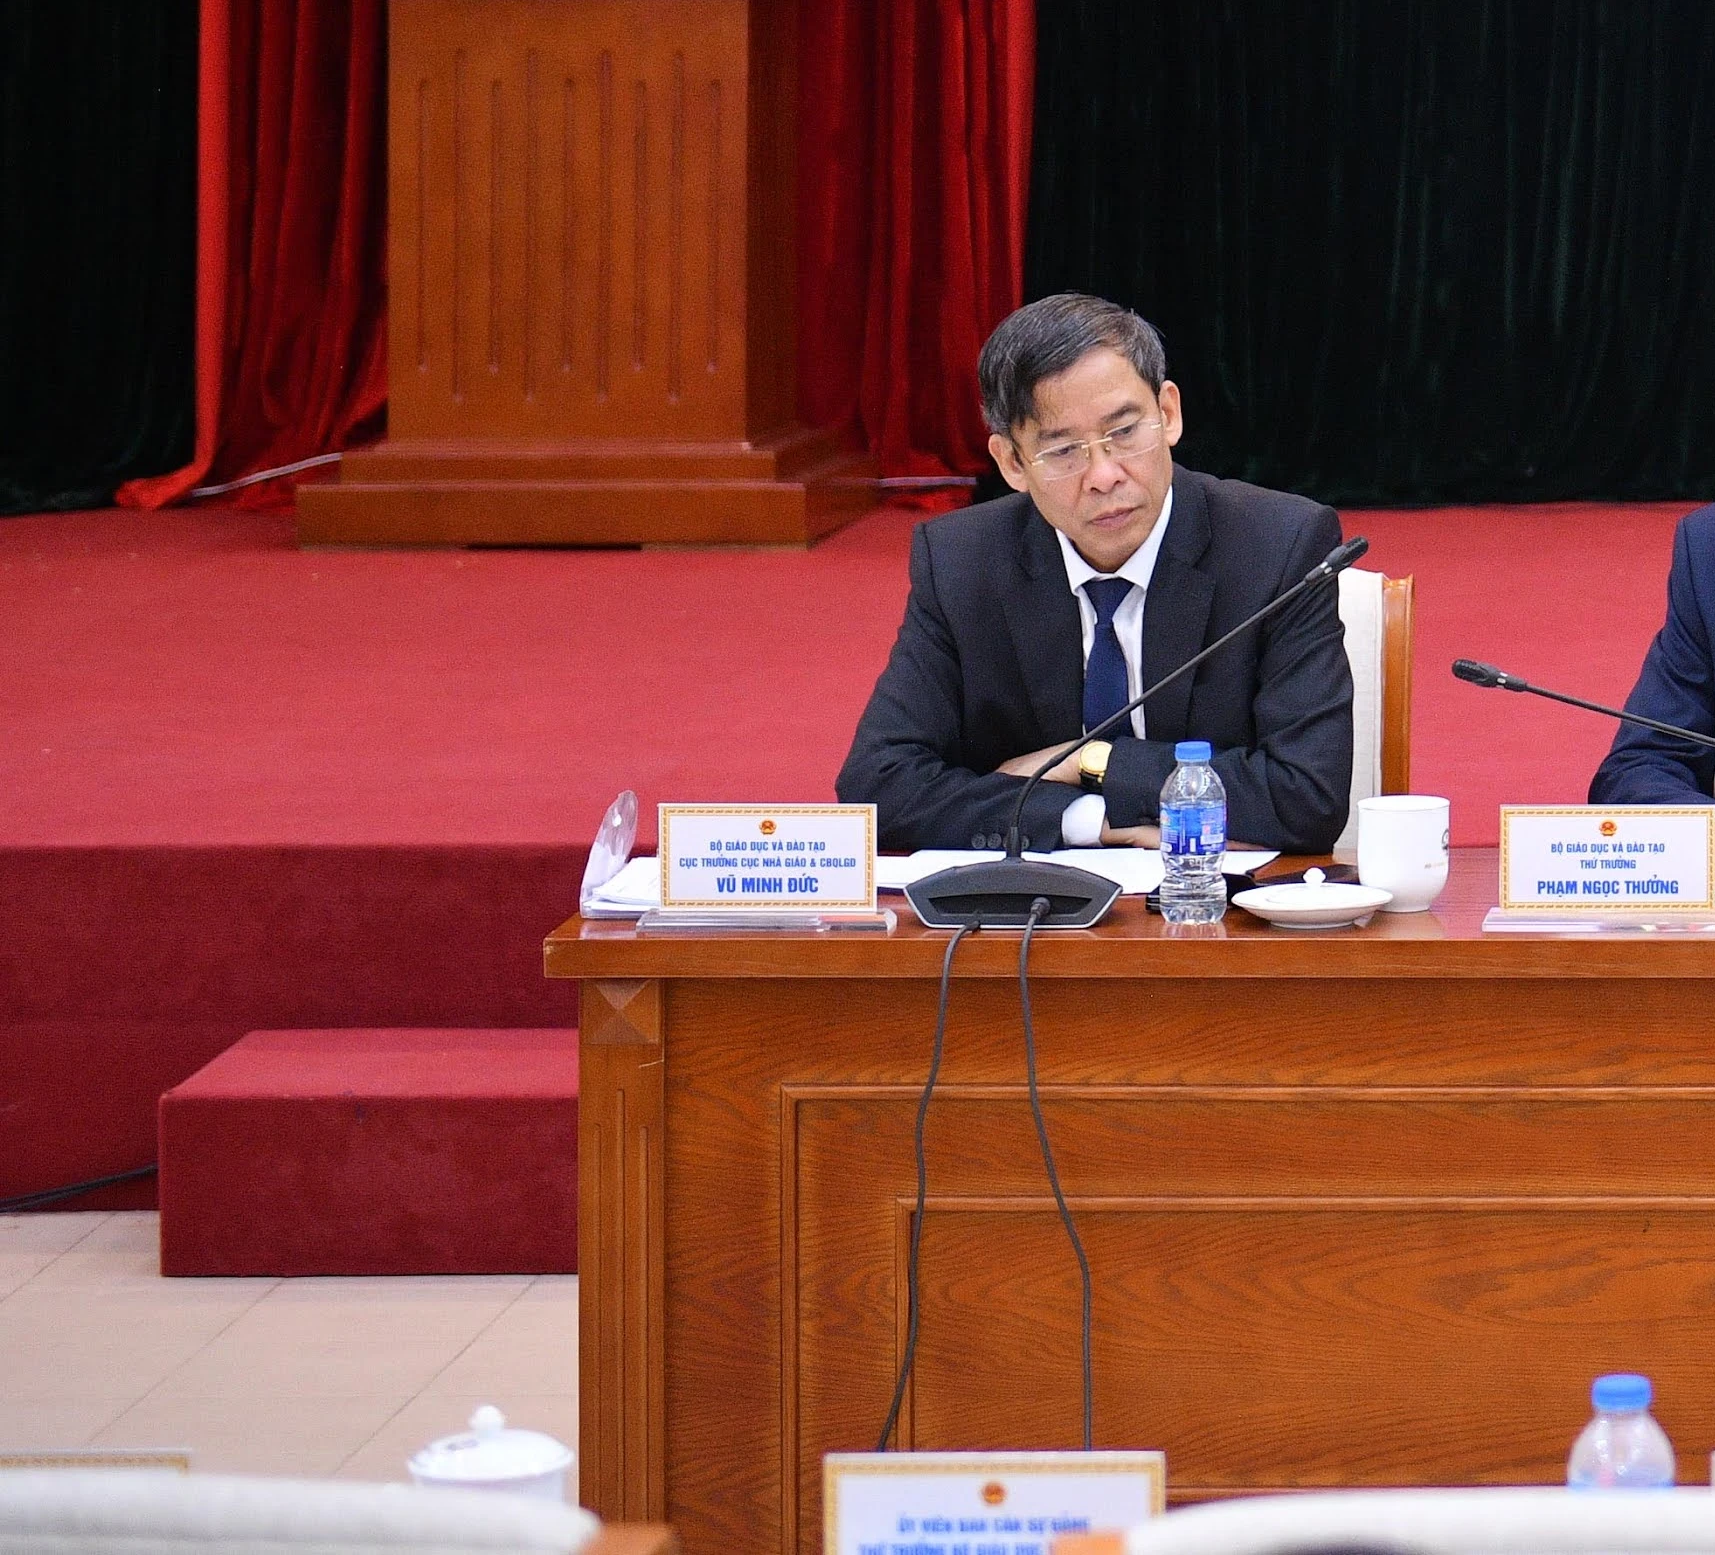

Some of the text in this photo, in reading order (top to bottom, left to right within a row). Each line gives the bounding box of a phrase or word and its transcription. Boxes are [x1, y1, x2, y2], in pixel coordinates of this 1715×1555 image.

[710, 839, 825, 853] BỘ GIÁO DỤC VÀ ĐÀO TẠO
[1551, 842, 1665, 855] BỘ GIÁO DỤC VÀ ĐÀO TẠO
[679, 854, 856, 869] CỤC TRƯỞNG CỤC NHÀ GIÁO & CBQLGD
[1580, 855, 1636, 869] THỨ TRƯỞNG
[716, 873, 818, 893] VŨ MINH ĐỨC
[1537, 875, 1679, 898] PHẠM NGỌC THƯỞNG
